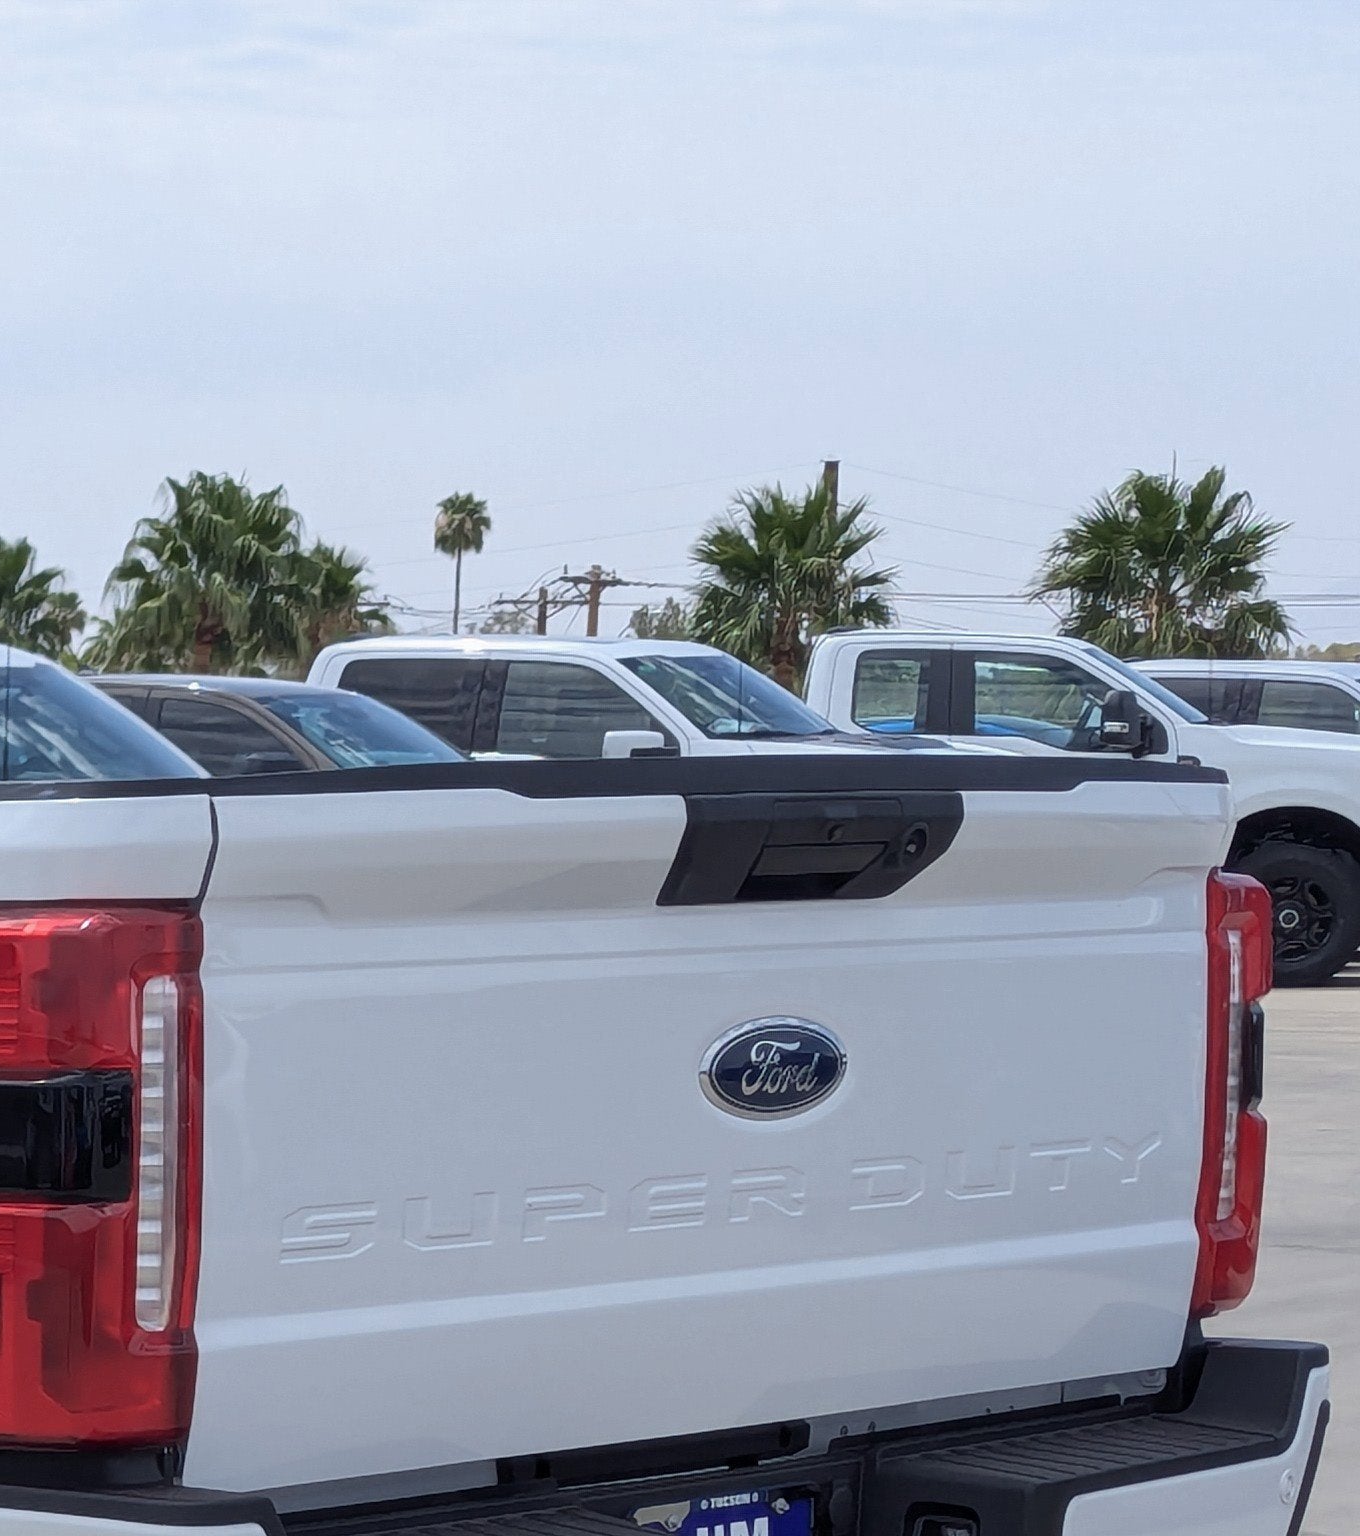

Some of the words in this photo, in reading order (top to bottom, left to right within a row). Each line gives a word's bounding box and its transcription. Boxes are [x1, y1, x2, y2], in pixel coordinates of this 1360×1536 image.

[741, 1040, 820, 1096] Ford
[280, 1165, 805, 1264] SUPER
[849, 1130, 1162, 1210] DUTY
